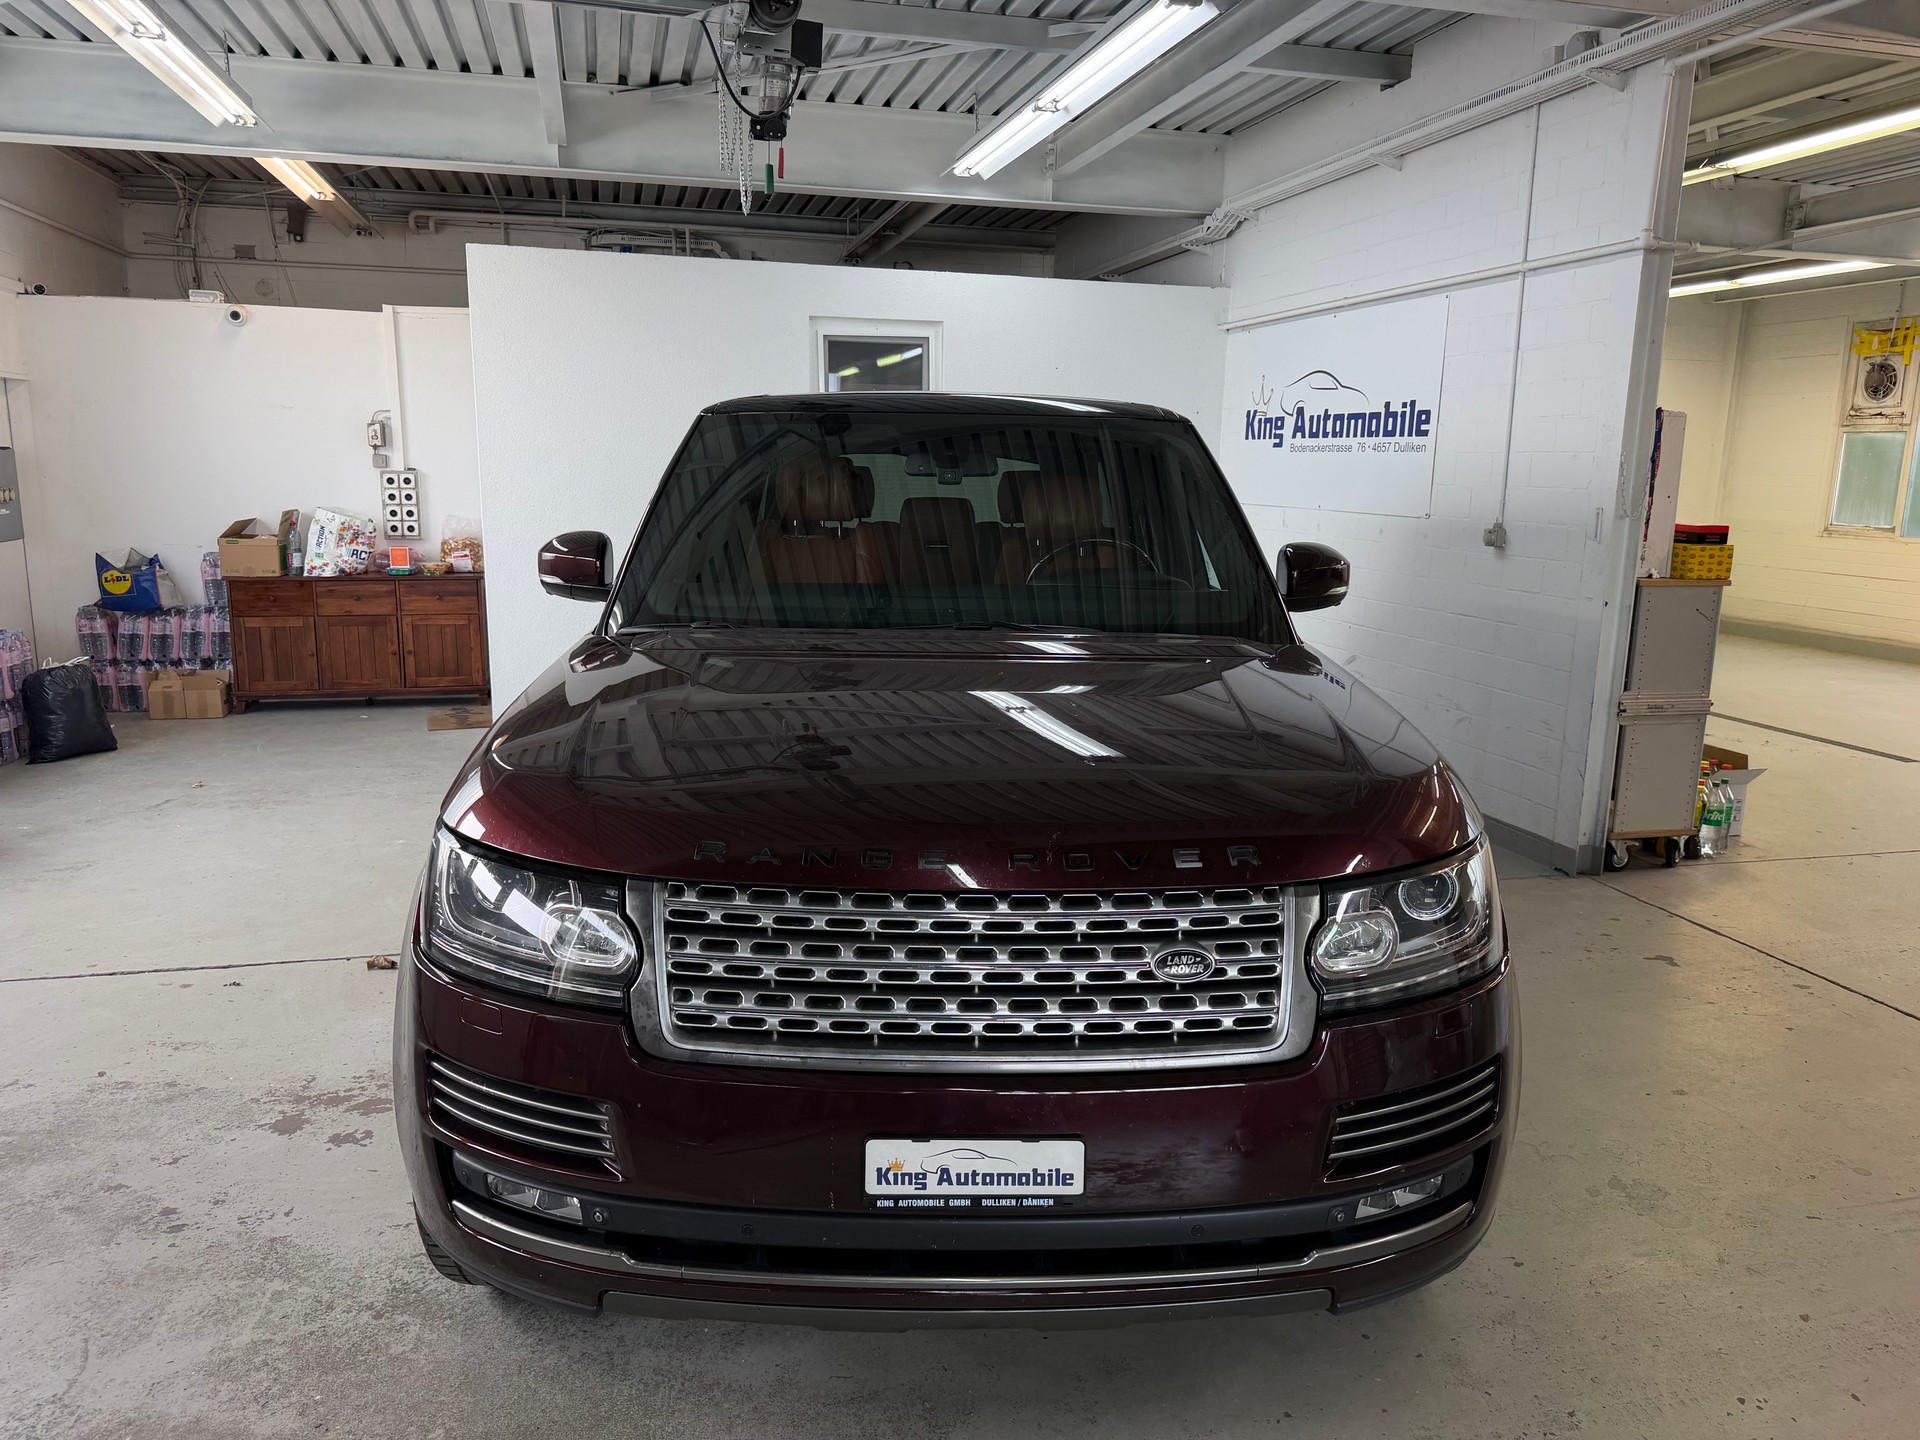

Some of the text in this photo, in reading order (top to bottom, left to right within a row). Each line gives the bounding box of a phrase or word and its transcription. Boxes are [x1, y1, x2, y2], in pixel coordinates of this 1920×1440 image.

[1245, 400, 1431, 448] King Automobile
[1289, 442, 1427, 453] Bodenackerstrasse 76 4657 Dulliken
[315, 525, 325, 548] ACTION
[693, 840, 1262, 871] RANGE ROVER
[1167, 955, 1195, 965] LAND
[1170, 964, 1204, 974] ROVER
[876, 1167, 1075, 1191] King Automobile
[876, 1199, 894, 1208] KING
[898, 1199, 945, 1208] AUTOMOBILE
[949, 1199, 971, 1207] GMBH
[982, 1198, 1016, 1207] DULLIKEN
